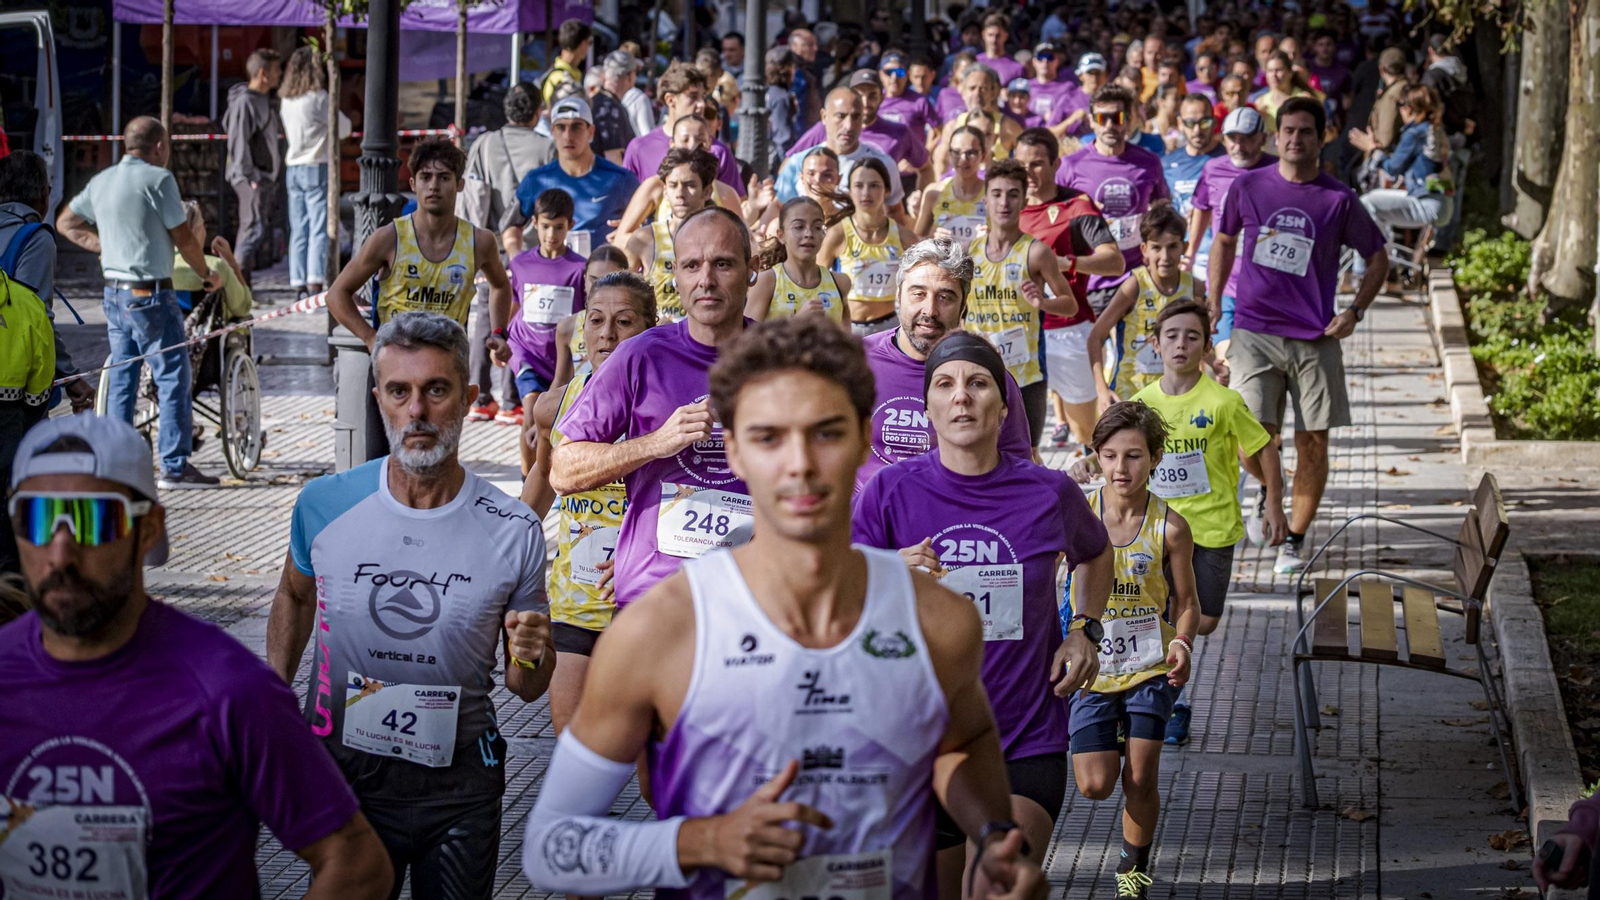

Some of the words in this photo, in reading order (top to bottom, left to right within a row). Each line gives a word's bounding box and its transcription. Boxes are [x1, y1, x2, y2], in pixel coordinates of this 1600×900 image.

[1104, 184, 1130, 195] 25N
[1276, 214, 1306, 228] 25N
[951, 226, 972, 237] 119
[1270, 242, 1296, 259] 278
[868, 273, 891, 285] 137
[538, 297, 555, 309] 57
[1001, 309, 1032, 323] CÁDIZ
[883, 408, 929, 428] 25N
[1163, 437, 1208, 454] SENIO
[684, 467, 703, 482] CONTRA
[711, 476, 740, 485] VIOLENCIA
[1159, 468, 1188, 482] 389
[721, 495, 755, 507] CARRER
[682, 510, 730, 536] 248
[942, 523, 963, 534] CONTRA
[972, 523, 999, 536] VIOLENCIA
[673, 535, 714, 546] TOLERANCIA
[939, 538, 998, 563] 25N
[585, 566, 605, 575] LUCHA
[978, 569, 1018, 577] CARRERA
[1121, 605, 1156, 618] CÁDIZ
[1125, 616, 1156, 626] CARRERA
[1101, 635, 1138, 656] 331
[367, 648, 413, 662] Vertical
[416, 654, 436, 665] 2.0
[381, 709, 418, 736] 42
[355, 728, 364, 736] TU
[366, 731, 392, 742] LUCHA
[393, 736, 403, 744] ES
[405, 739, 414, 747] MI
[414, 742, 441, 751] LUCHA
[27, 765, 114, 804] 25N
[74, 813, 137, 825] CARRERA
[27, 841, 99, 882] 382
